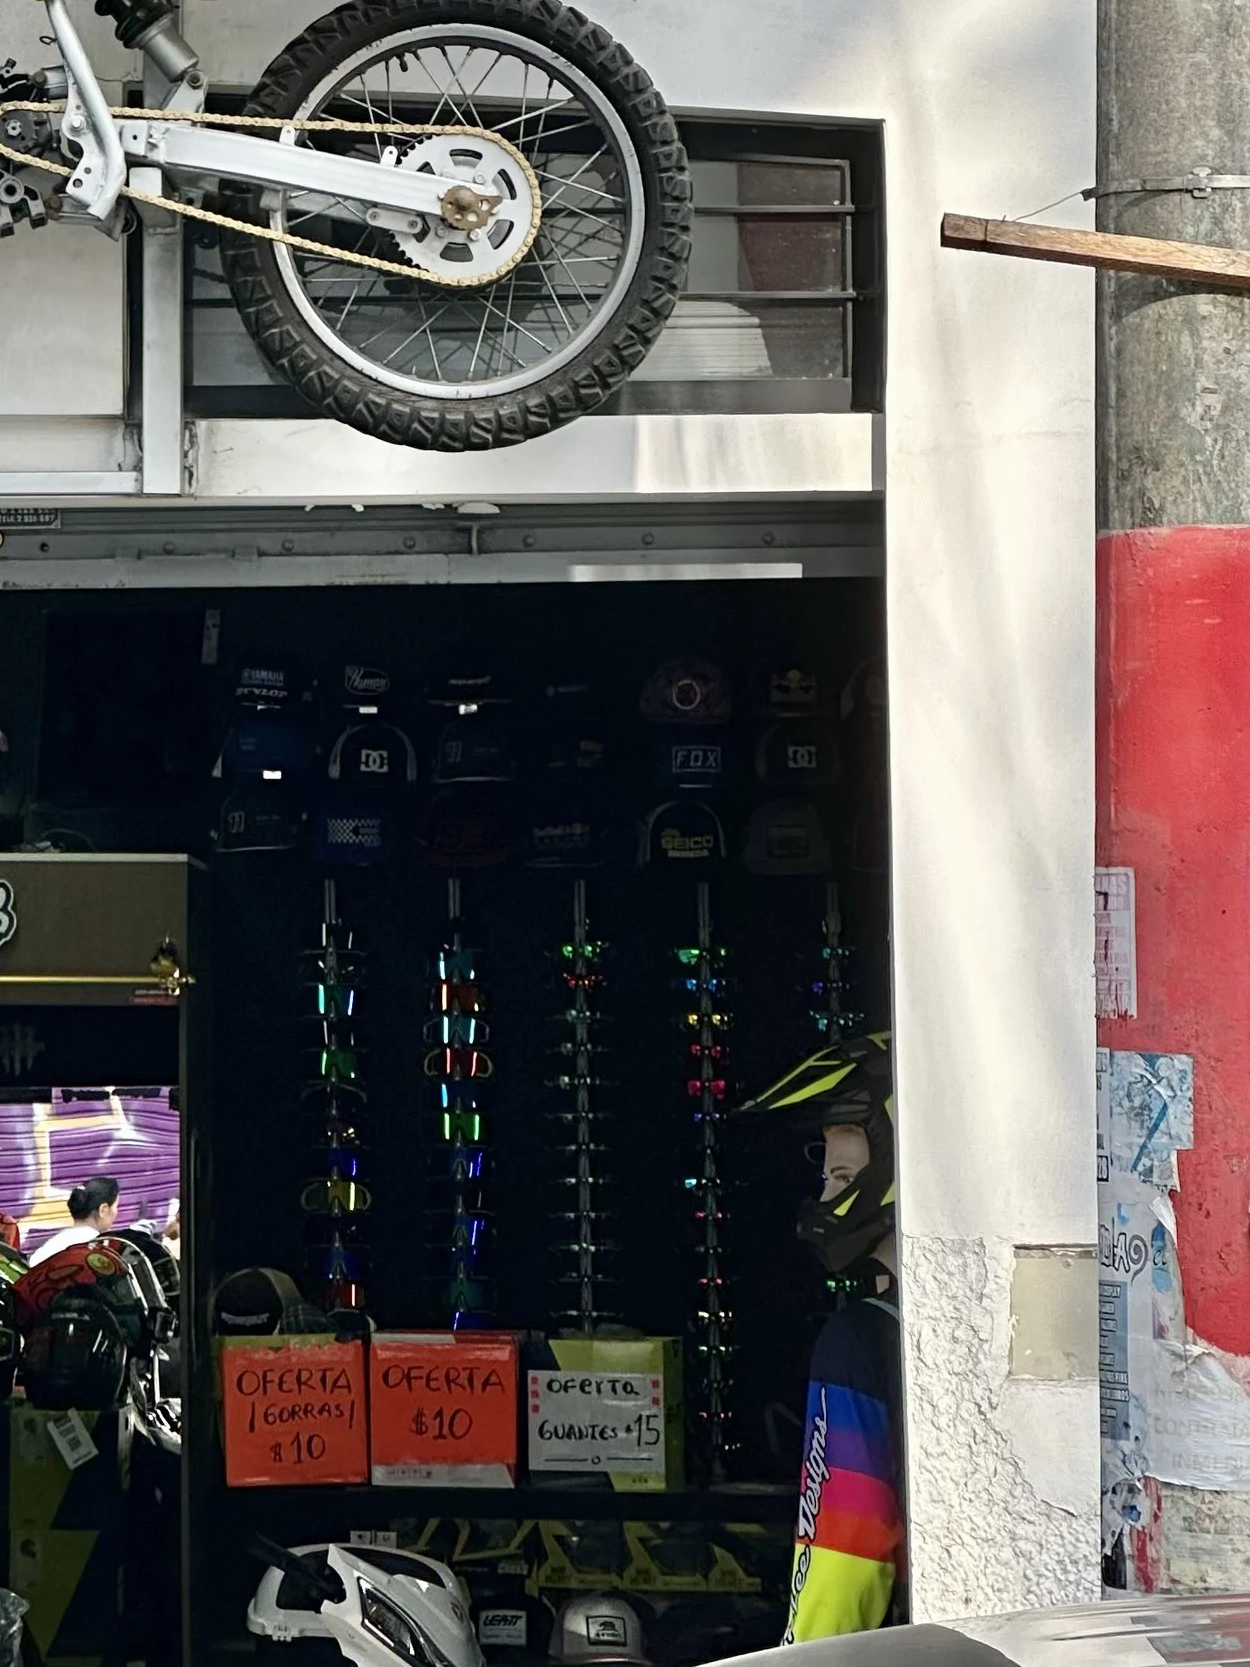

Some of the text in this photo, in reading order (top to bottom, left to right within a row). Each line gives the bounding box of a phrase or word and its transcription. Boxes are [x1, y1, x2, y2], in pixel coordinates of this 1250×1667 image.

[661, 834, 714, 849] GEICO
[236, 1367, 353, 1396] OFERTA
[382, 1364, 505, 1396] OFERTA
[409, 1405, 473, 1440] $10
[538, 1419, 619, 1441] GUANTES
[798, 1387, 829, 1540] Designs
[483, 1614, 523, 1627] LEATT
